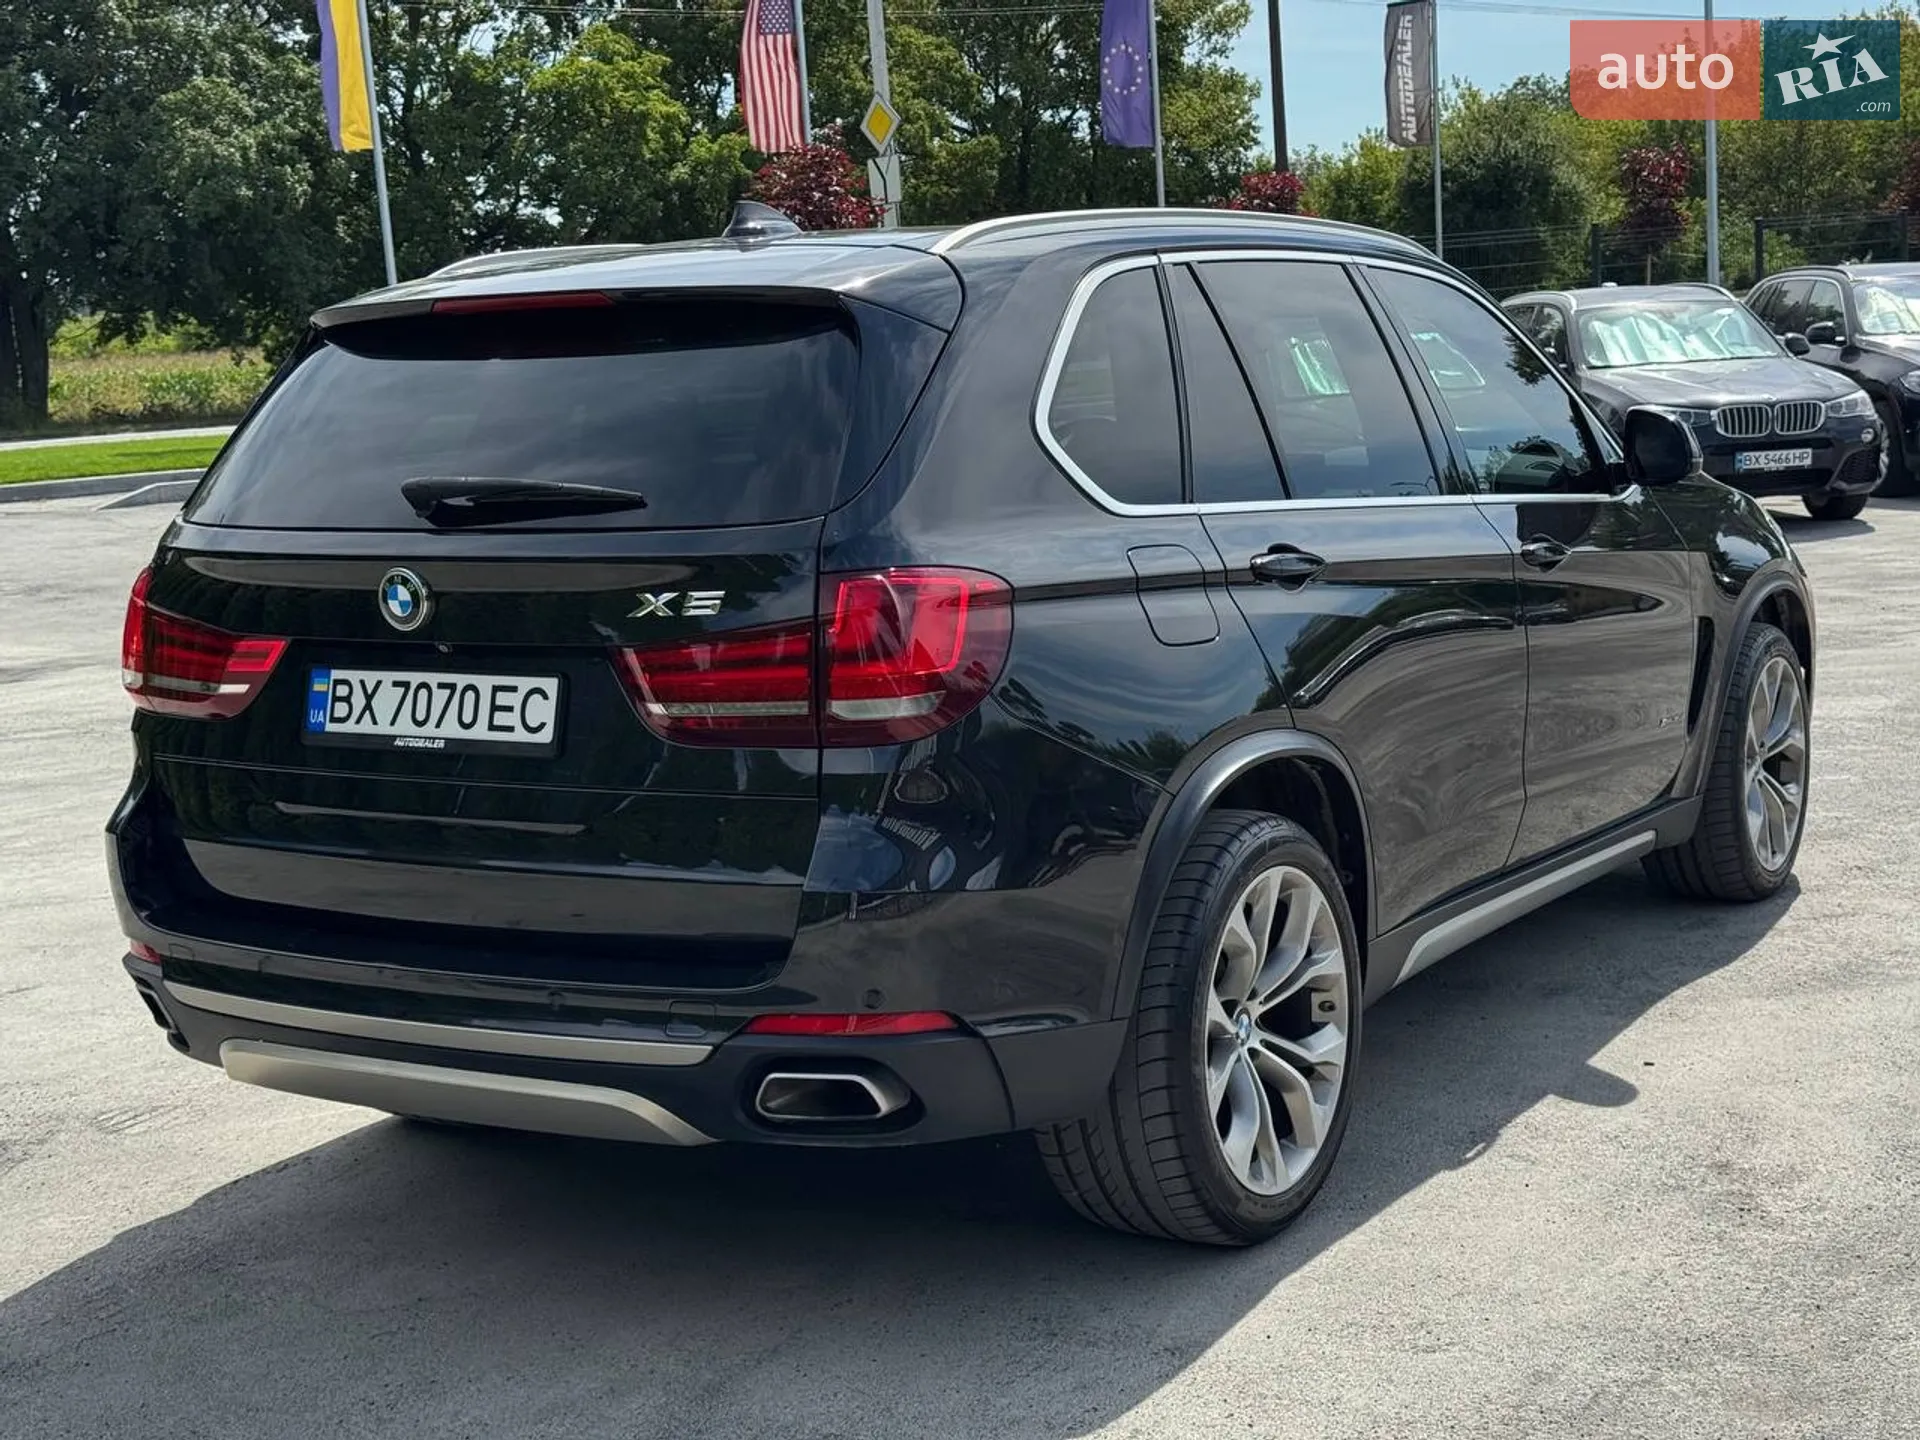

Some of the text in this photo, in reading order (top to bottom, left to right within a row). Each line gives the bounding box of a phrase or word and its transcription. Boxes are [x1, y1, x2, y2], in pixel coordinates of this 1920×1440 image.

[1397, 14, 1417, 143] AUTODEALER
[626, 591, 726, 618] X5
[310, 709, 324, 723] UA
[329, 678, 550, 735] BX 7070 EC
